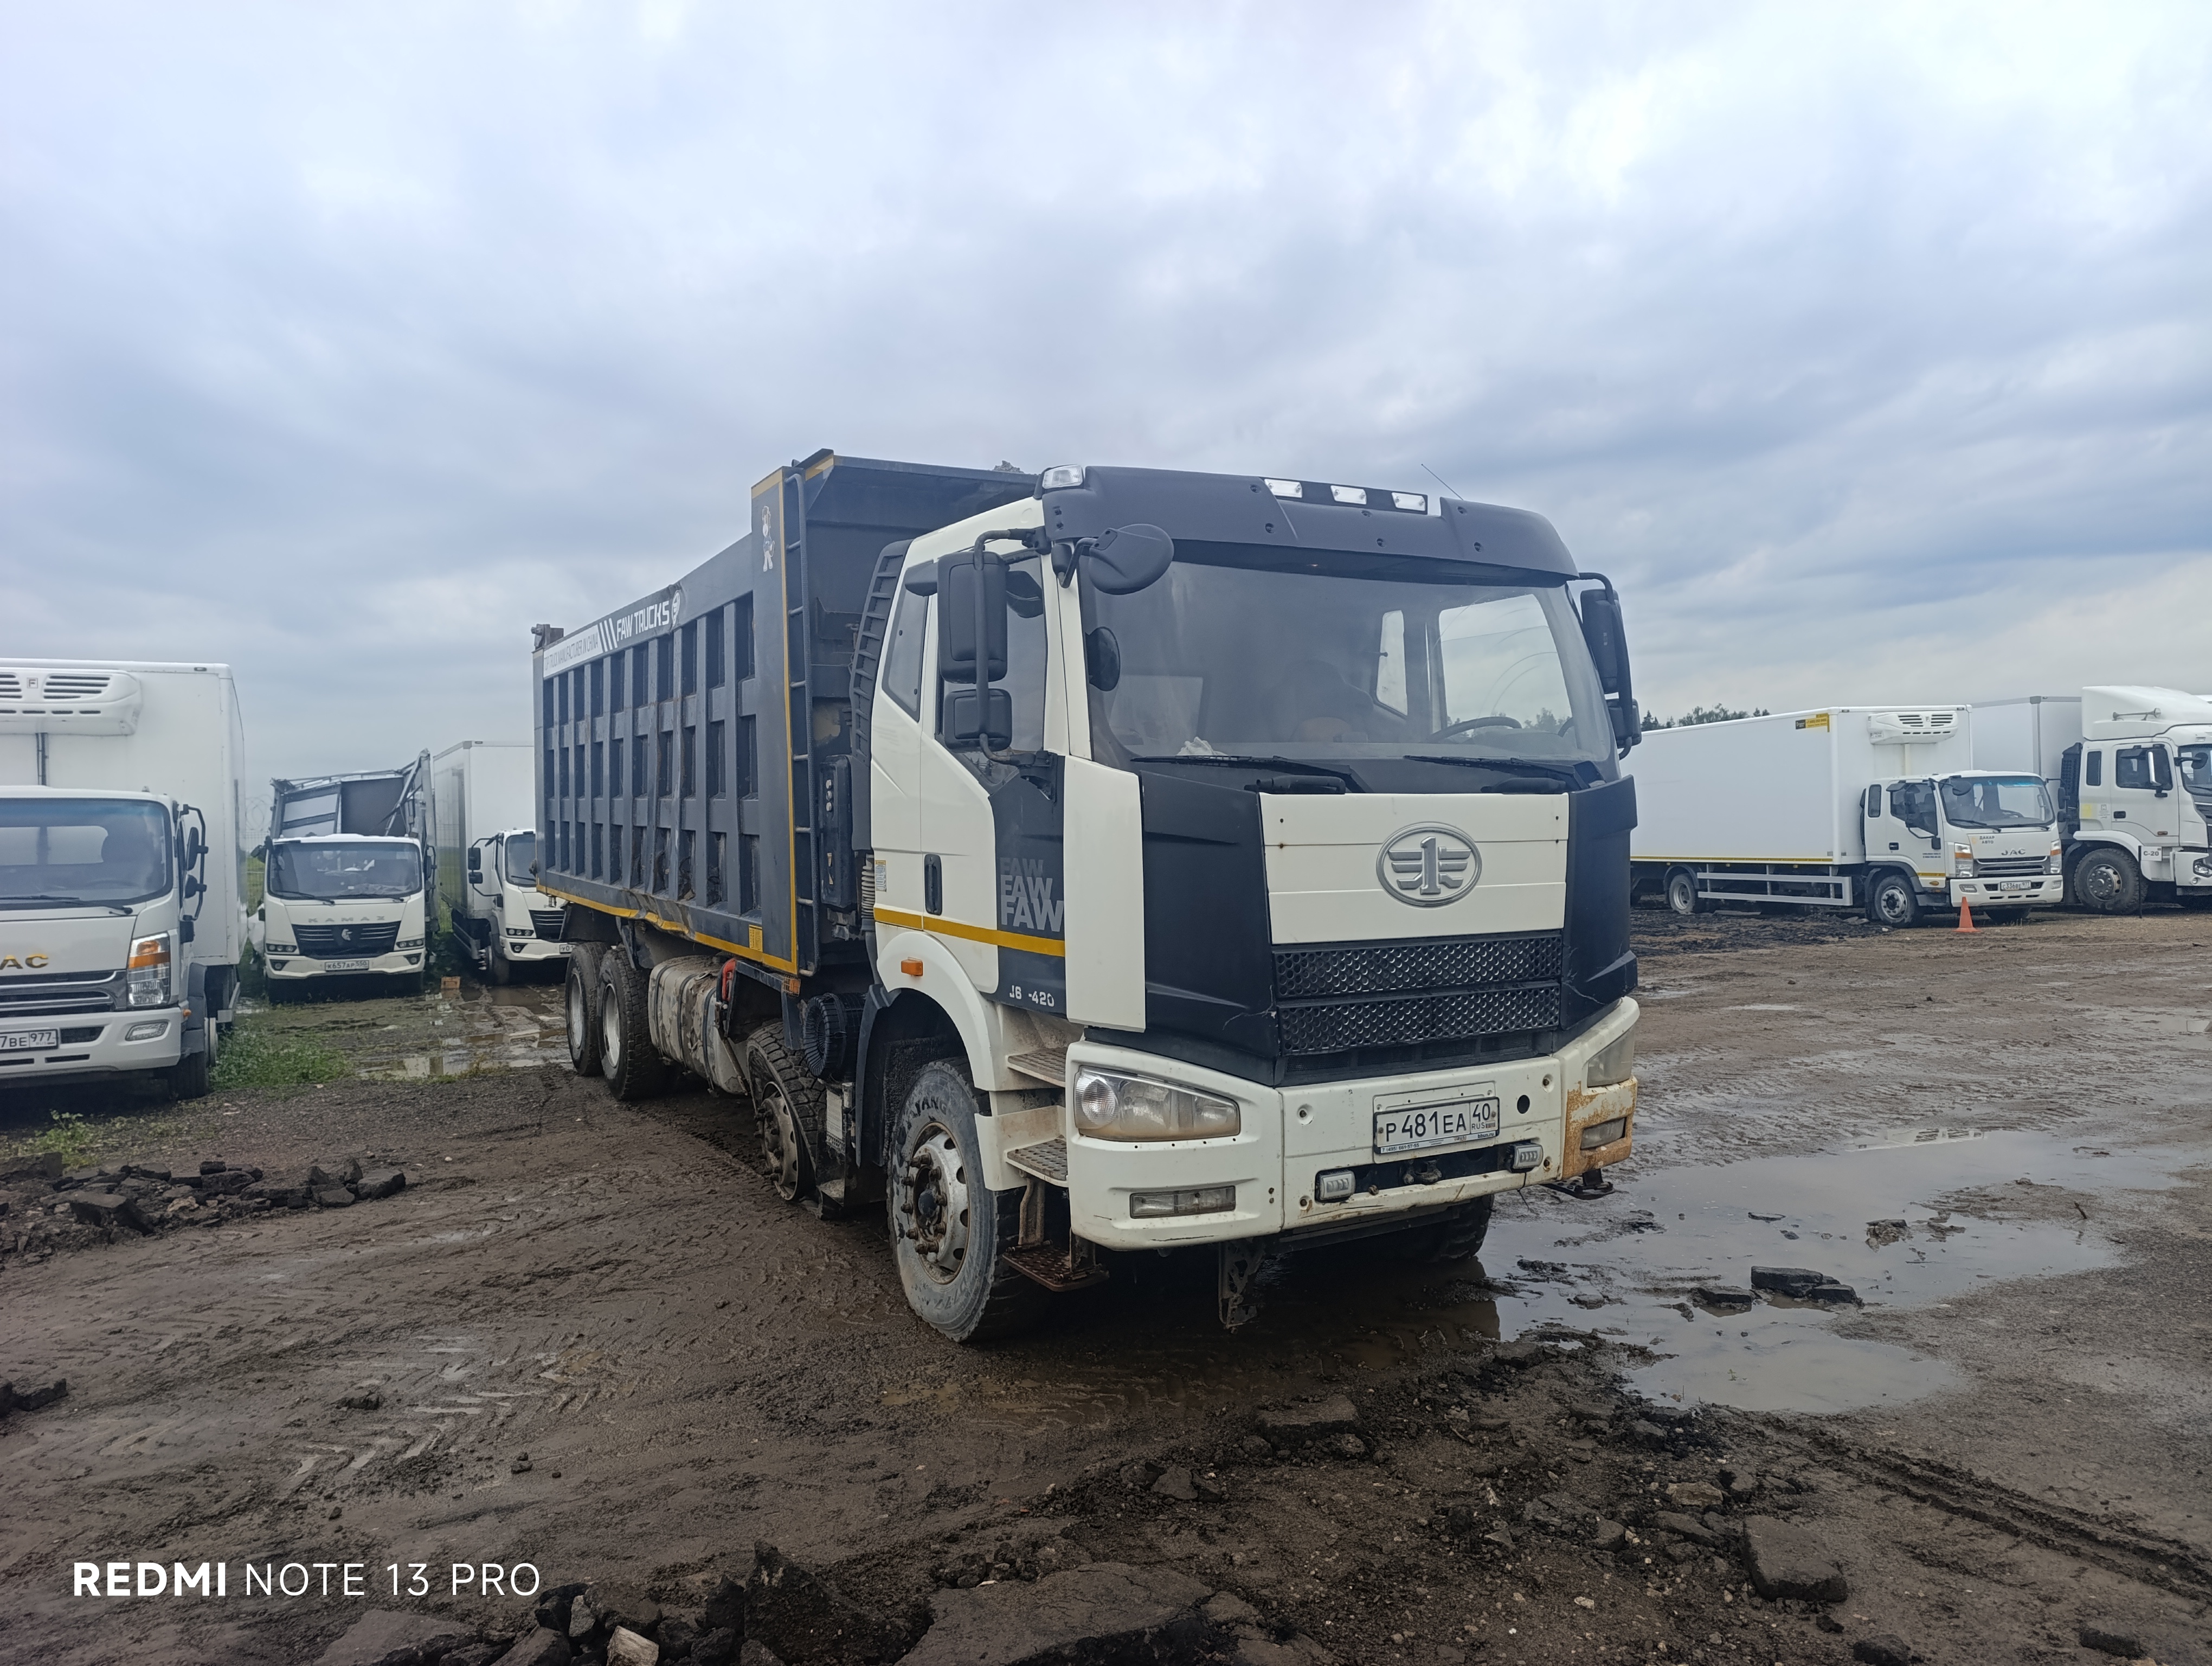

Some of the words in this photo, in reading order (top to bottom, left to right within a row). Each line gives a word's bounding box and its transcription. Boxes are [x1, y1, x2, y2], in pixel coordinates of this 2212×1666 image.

[616, 613, 633, 642] FAW
[634, 600, 670, 635] TRUCKS
[1000, 857, 1044, 878] FAW
[1000, 874, 1053, 902] FAW
[1001, 895, 1064, 932] FAW
[1009, 985, 1022, 999] J6
[30, 1032, 52, 1042] 977
[1472, 1103, 1491, 1122] 40
[1471, 1122, 1486, 1130] RUS
